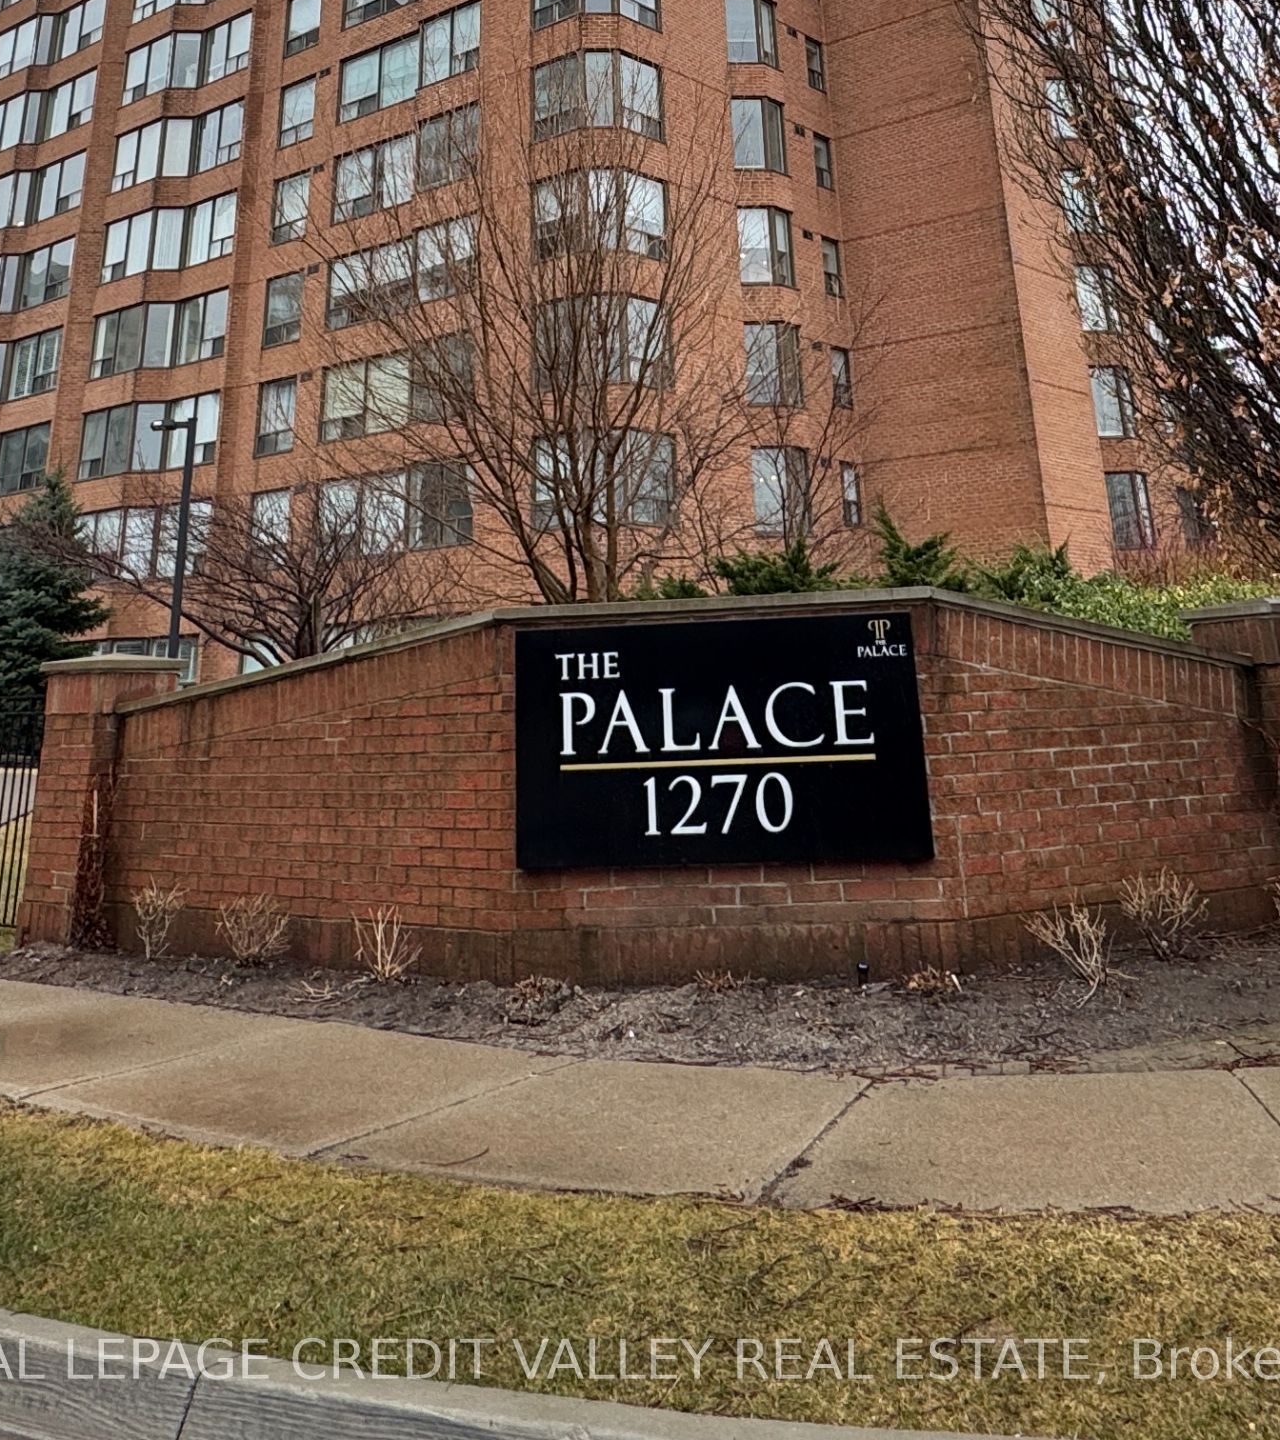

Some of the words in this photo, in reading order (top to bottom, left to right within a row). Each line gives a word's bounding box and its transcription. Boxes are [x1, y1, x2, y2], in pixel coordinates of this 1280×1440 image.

[555, 651, 620, 681] THE
[857, 644, 908, 658] PALACE
[558, 679, 876, 756] PALACE
[642, 771, 794, 836] 1270
